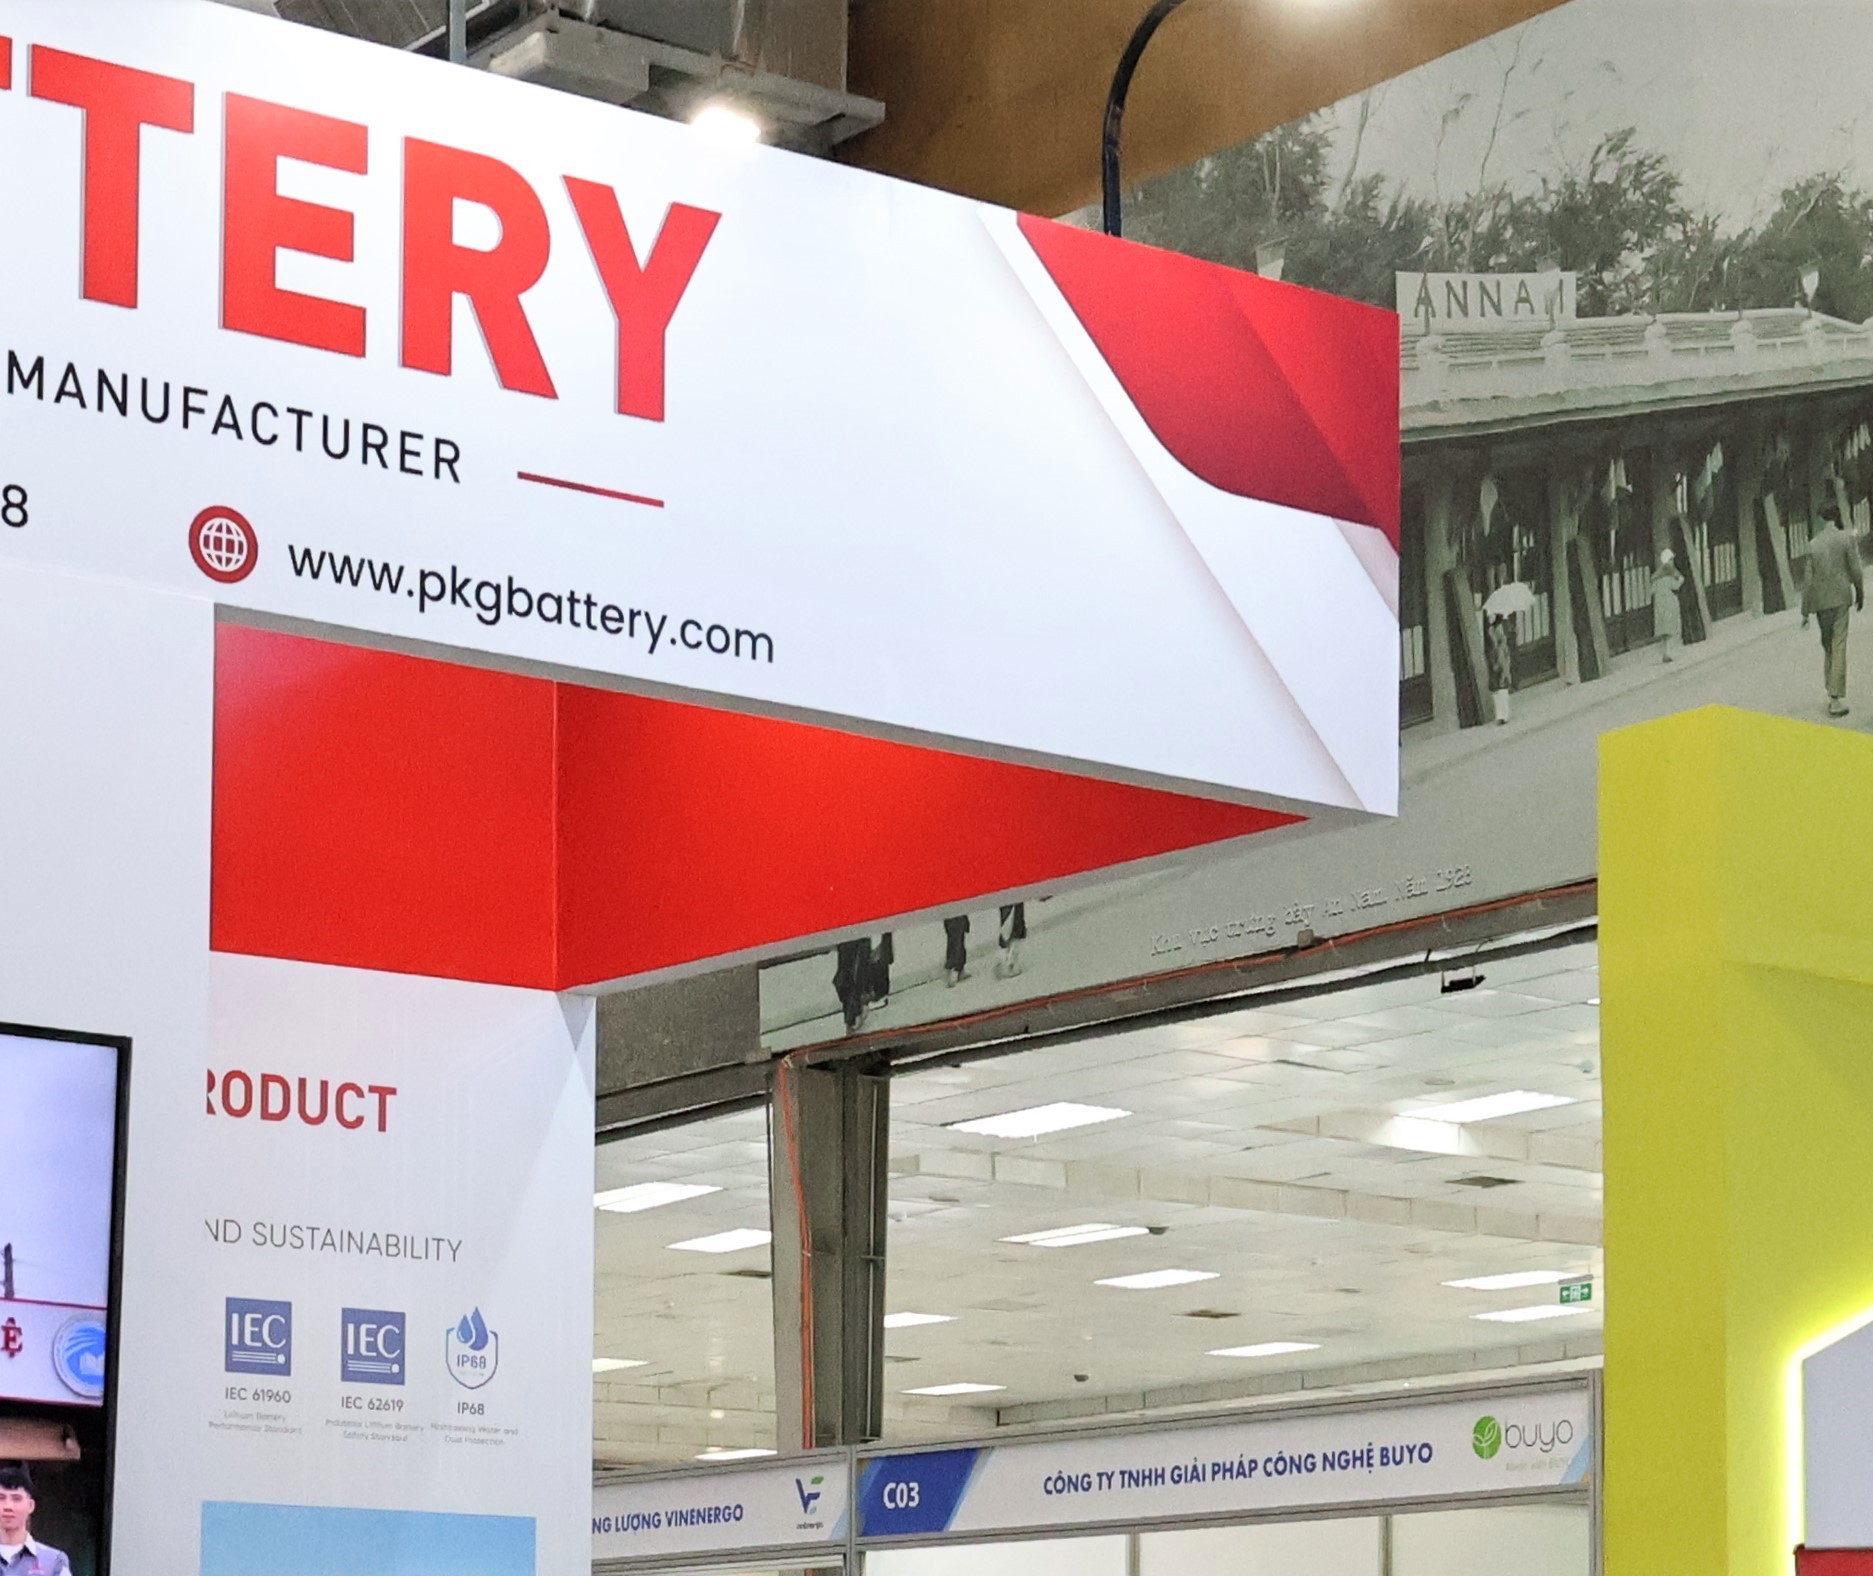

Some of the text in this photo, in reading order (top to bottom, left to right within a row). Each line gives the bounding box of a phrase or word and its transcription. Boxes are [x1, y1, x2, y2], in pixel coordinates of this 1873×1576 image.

[7, 350, 460, 483] MANUFACTURER
[288, 541, 776, 665] www.pkgbattery.com
[252, 1222, 462, 1262] SUSTAINABILITY
[231, 1314, 286, 1346] IEC
[347, 1324, 401, 1357] IEC
[225, 1387, 247, 1400] IEC
[341, 1396, 362, 1410] IEC
[458, 1402, 484, 1415] IP68
[1505, 1419, 1573, 1453] buyo
[1044, 1442, 1433, 1495] CÔNG TY TNHH GIẢI PHÁP CÔNG NGHỆ BUYO
[884, 1482, 919, 1508] C03
[615, 1504, 743, 1535] LƯỢNG VINENERGO
